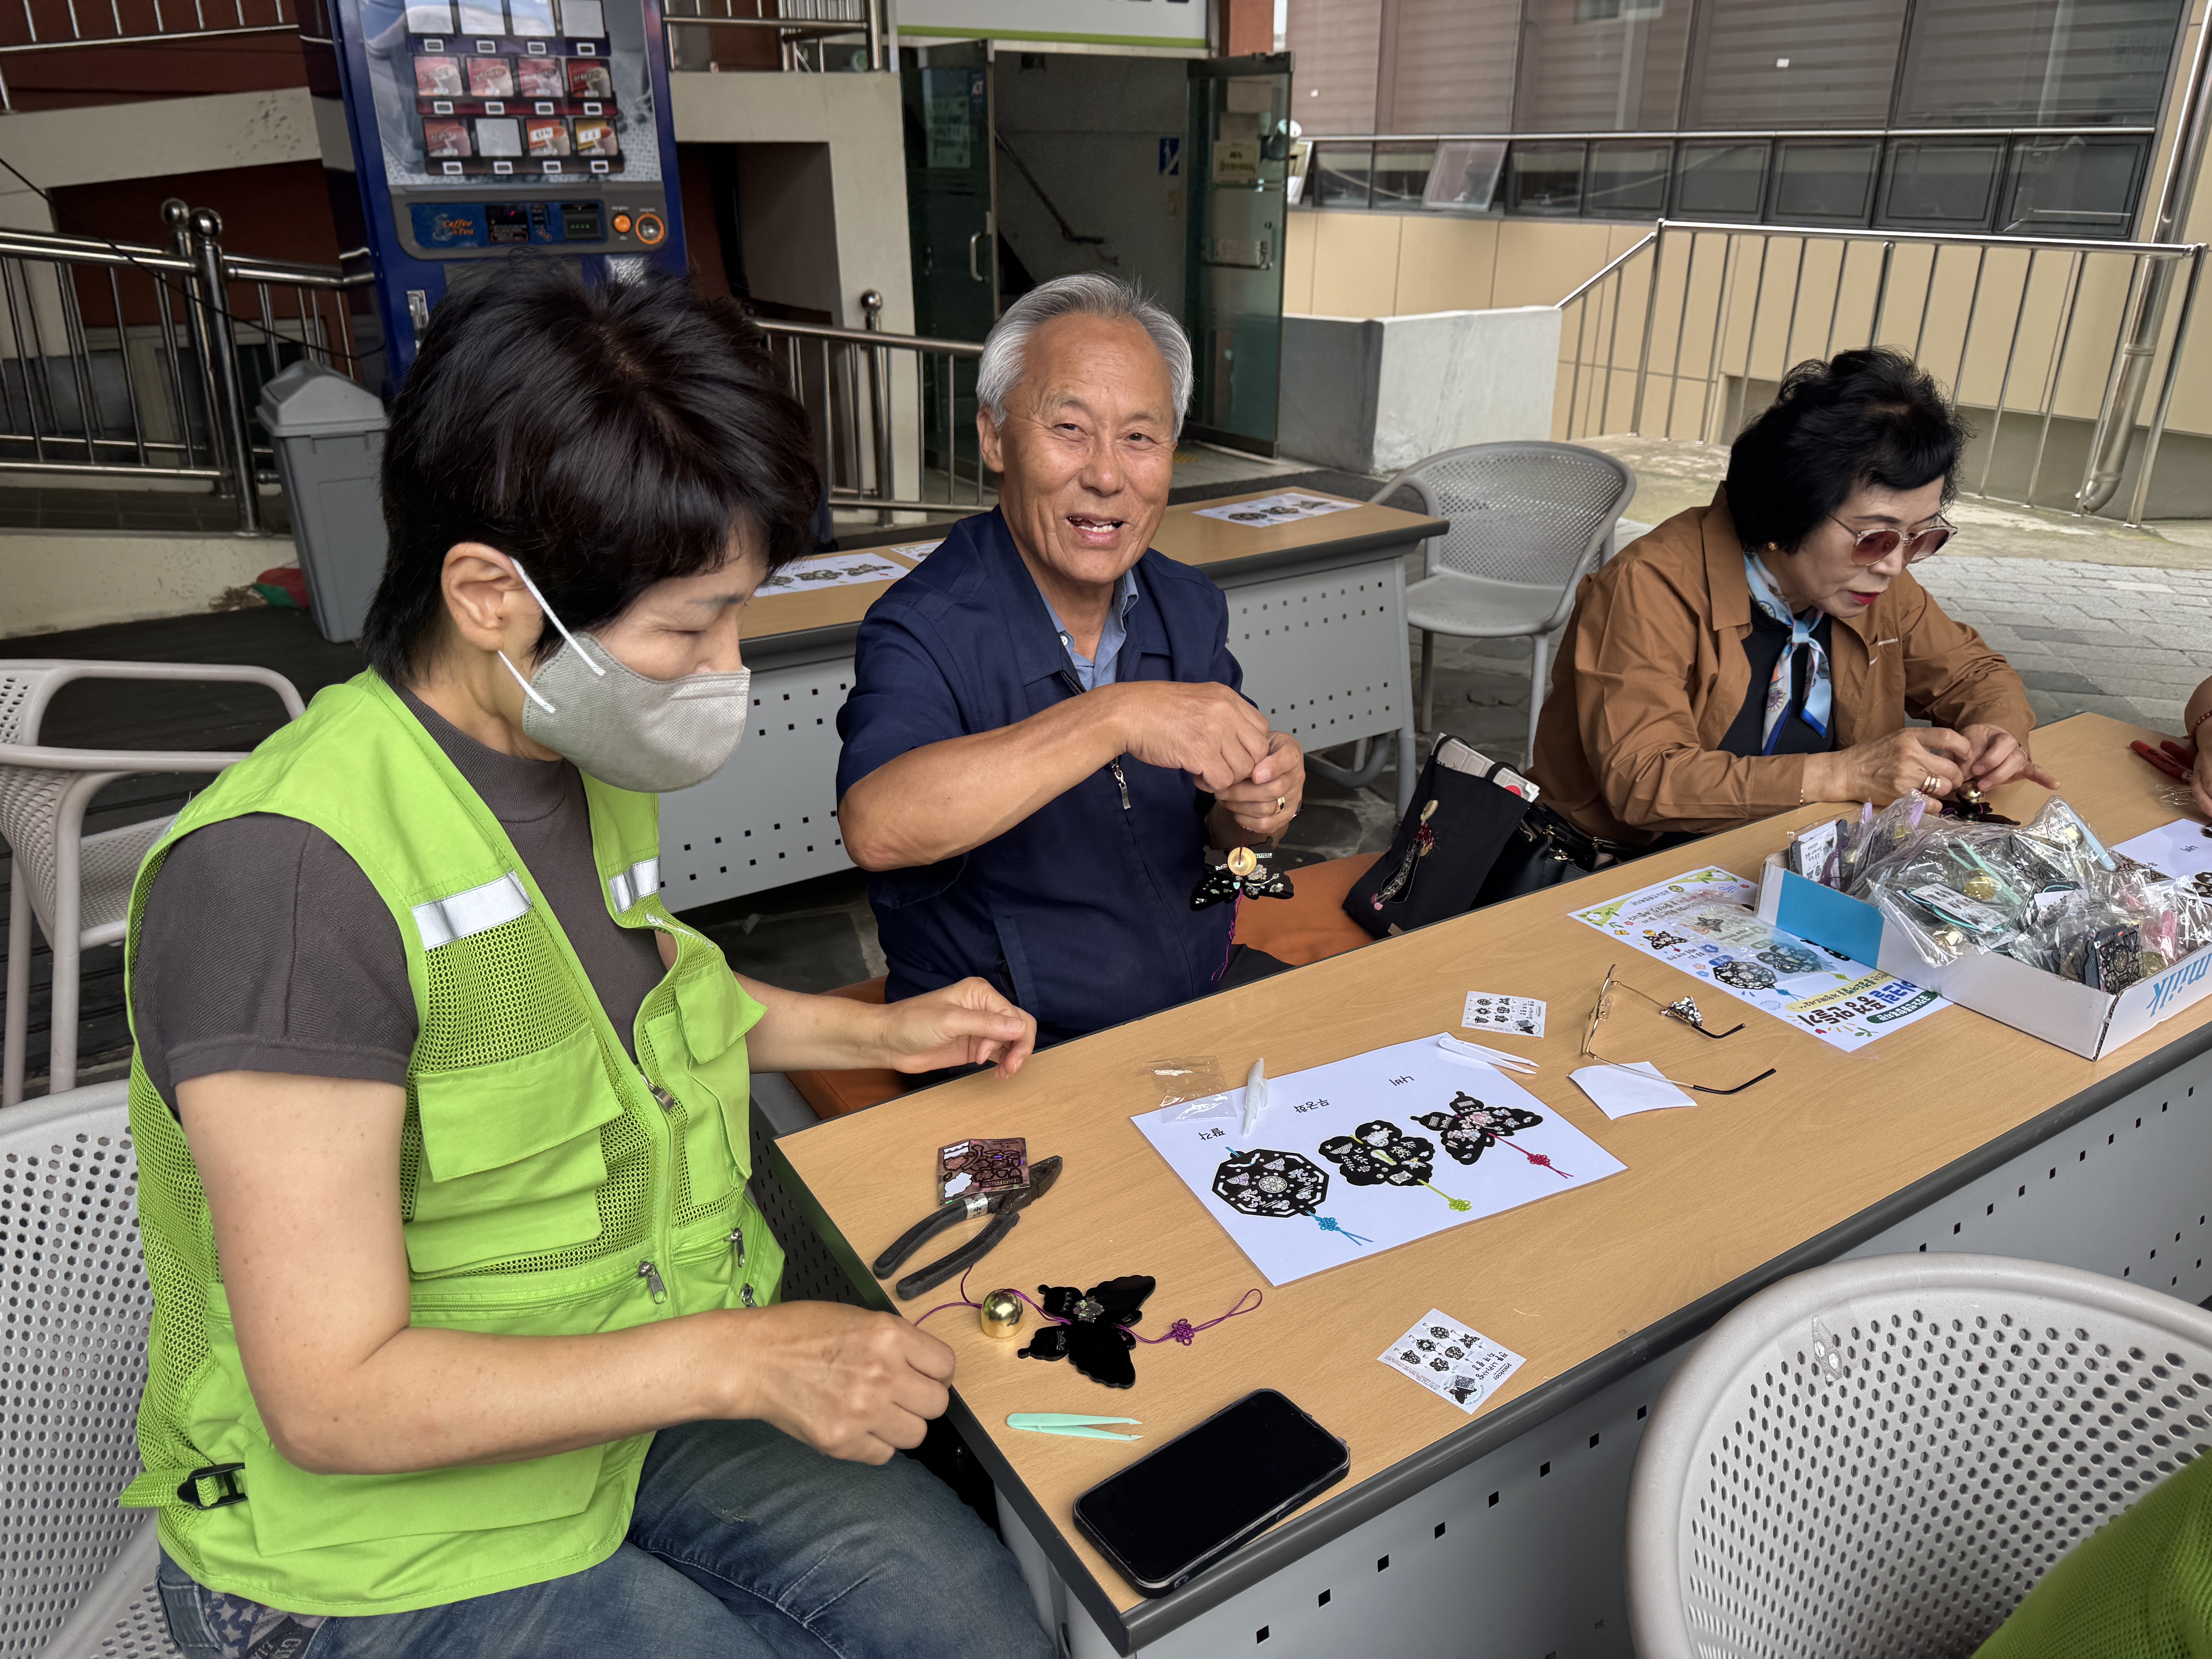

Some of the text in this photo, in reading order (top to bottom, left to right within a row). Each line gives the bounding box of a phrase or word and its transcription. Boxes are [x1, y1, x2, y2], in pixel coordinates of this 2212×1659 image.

[1798, 980, 1917, 1026] 아크릴 풍경 만들기
[1878, 995, 1930, 1020] 금강노인종합복지관
[1389, 1076, 1414, 1086] 나비
[1293, 1099, 1329, 1113] 무궁화
[1198, 1128, 1226, 1140] 팔각
[1472, 1361, 1485, 1371] 풍경
[1475, 1362, 1498, 1380] 나라사랑
